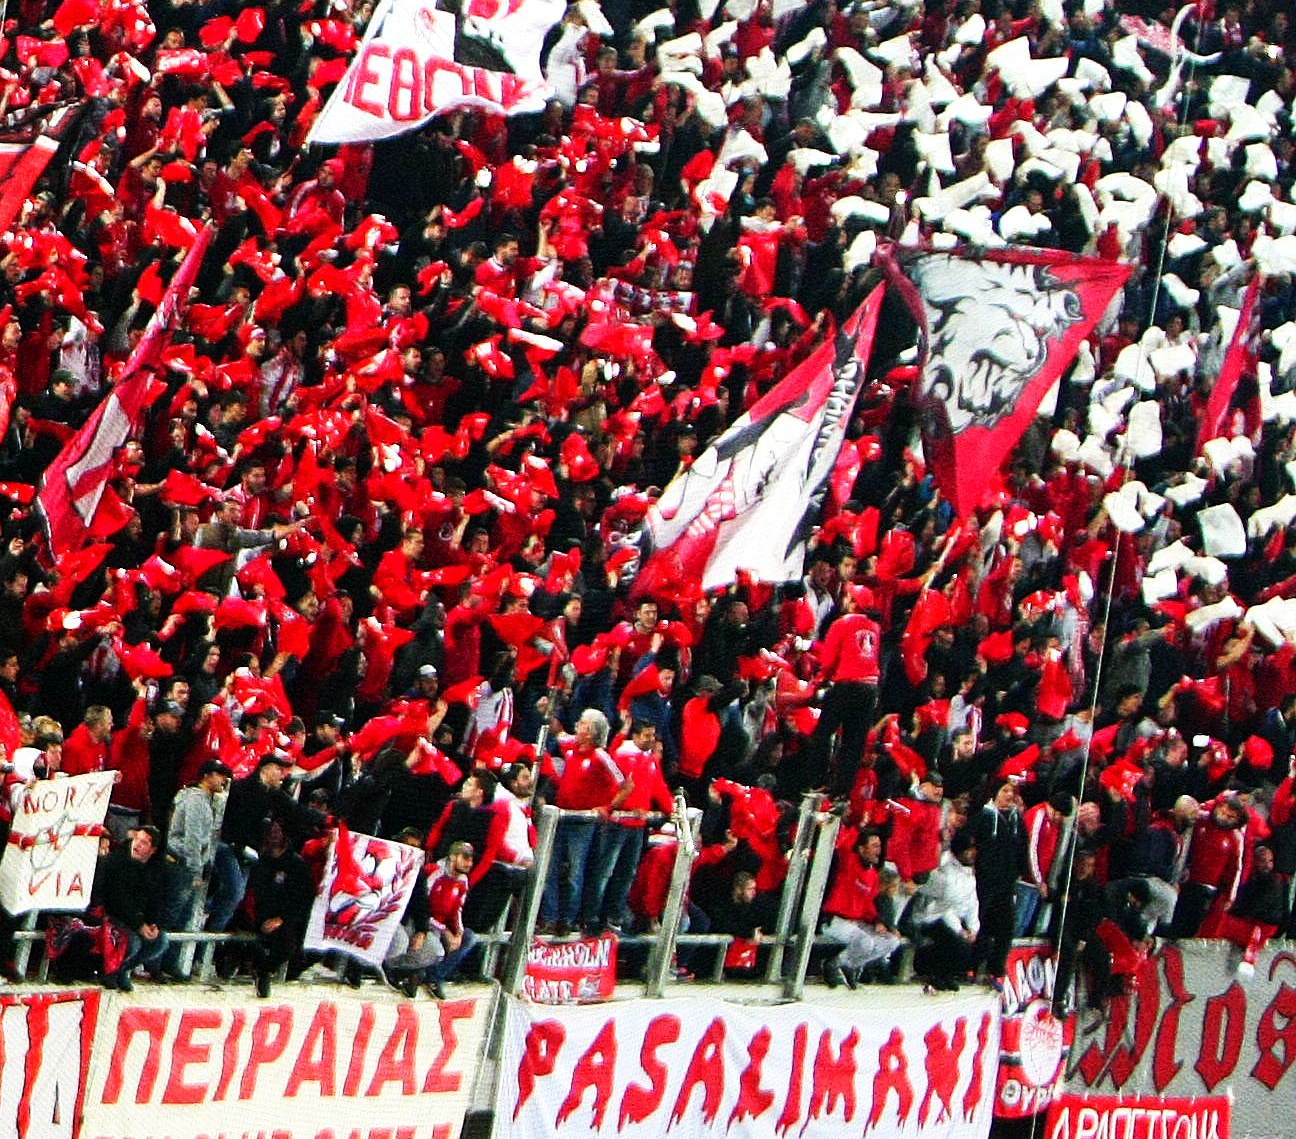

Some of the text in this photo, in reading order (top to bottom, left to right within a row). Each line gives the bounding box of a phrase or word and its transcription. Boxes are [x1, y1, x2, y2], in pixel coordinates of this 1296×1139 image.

[28, 870, 84, 898] VIA
[101, 998, 475, 1105] ΠΕΙΡΑΙΑΣ
[512, 1009, 993, 1136] PASALIMANI
